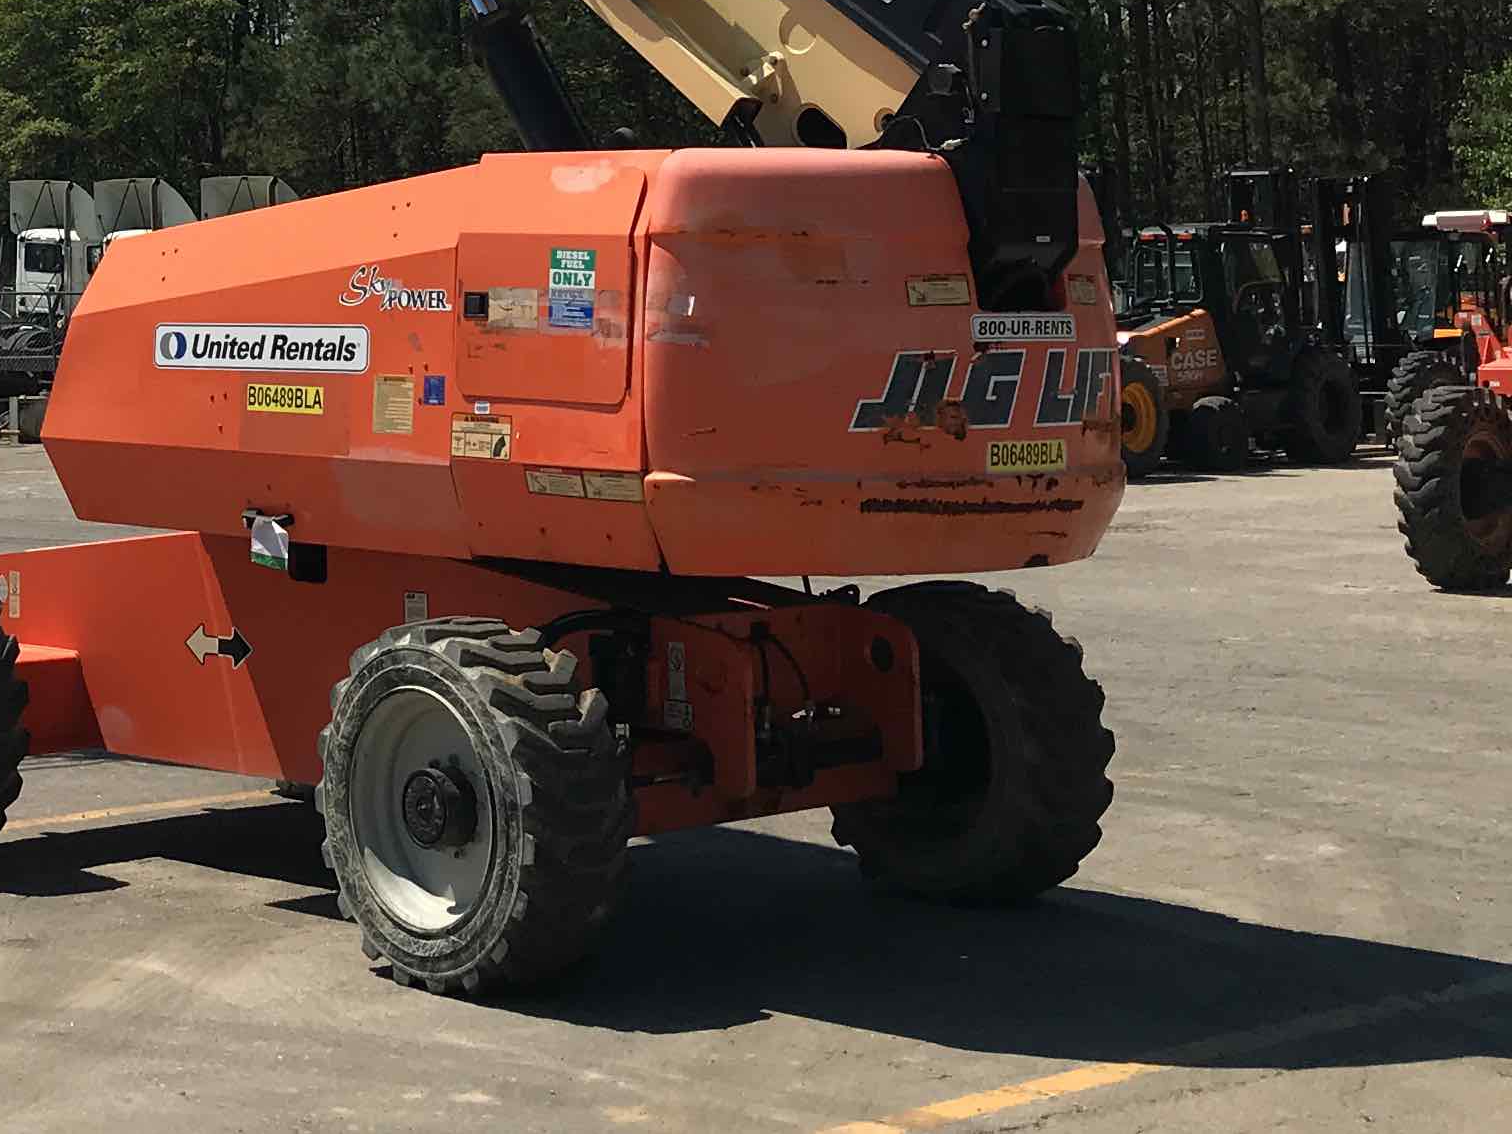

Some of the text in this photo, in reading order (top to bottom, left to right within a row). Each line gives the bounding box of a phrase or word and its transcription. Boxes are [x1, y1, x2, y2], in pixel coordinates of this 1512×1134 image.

[556, 250, 590, 260] DIESEL
[560, 259, 585, 269] FUEL
[552, 271, 593, 287] ONLY
[387, 288, 452, 311] POWER
[978, 320, 1072, 336] 800-UR-RENTS
[191, 333, 357, 362] United Rentals
[1171, 349, 1217, 371] CASE
[248, 385, 322, 409] B06489BLA
[990, 441, 1064, 467] B06489BLA
